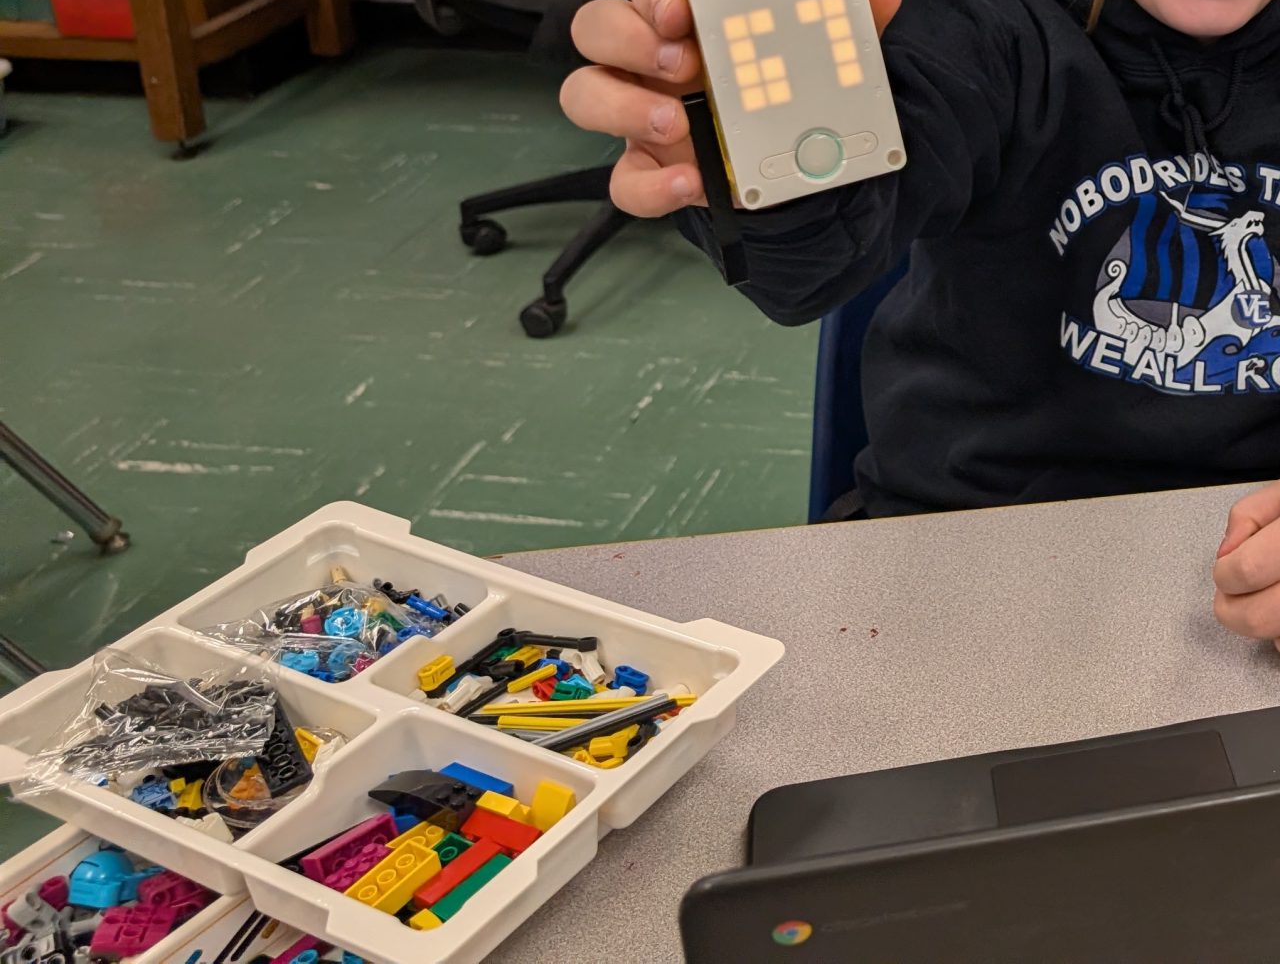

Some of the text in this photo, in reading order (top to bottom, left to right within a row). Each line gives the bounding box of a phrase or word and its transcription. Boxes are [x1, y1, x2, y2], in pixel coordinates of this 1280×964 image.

[1237, 293, 1272, 324] VC
[1060, 311, 1127, 374] WE
[1132, 350, 1222, 392] ALL
